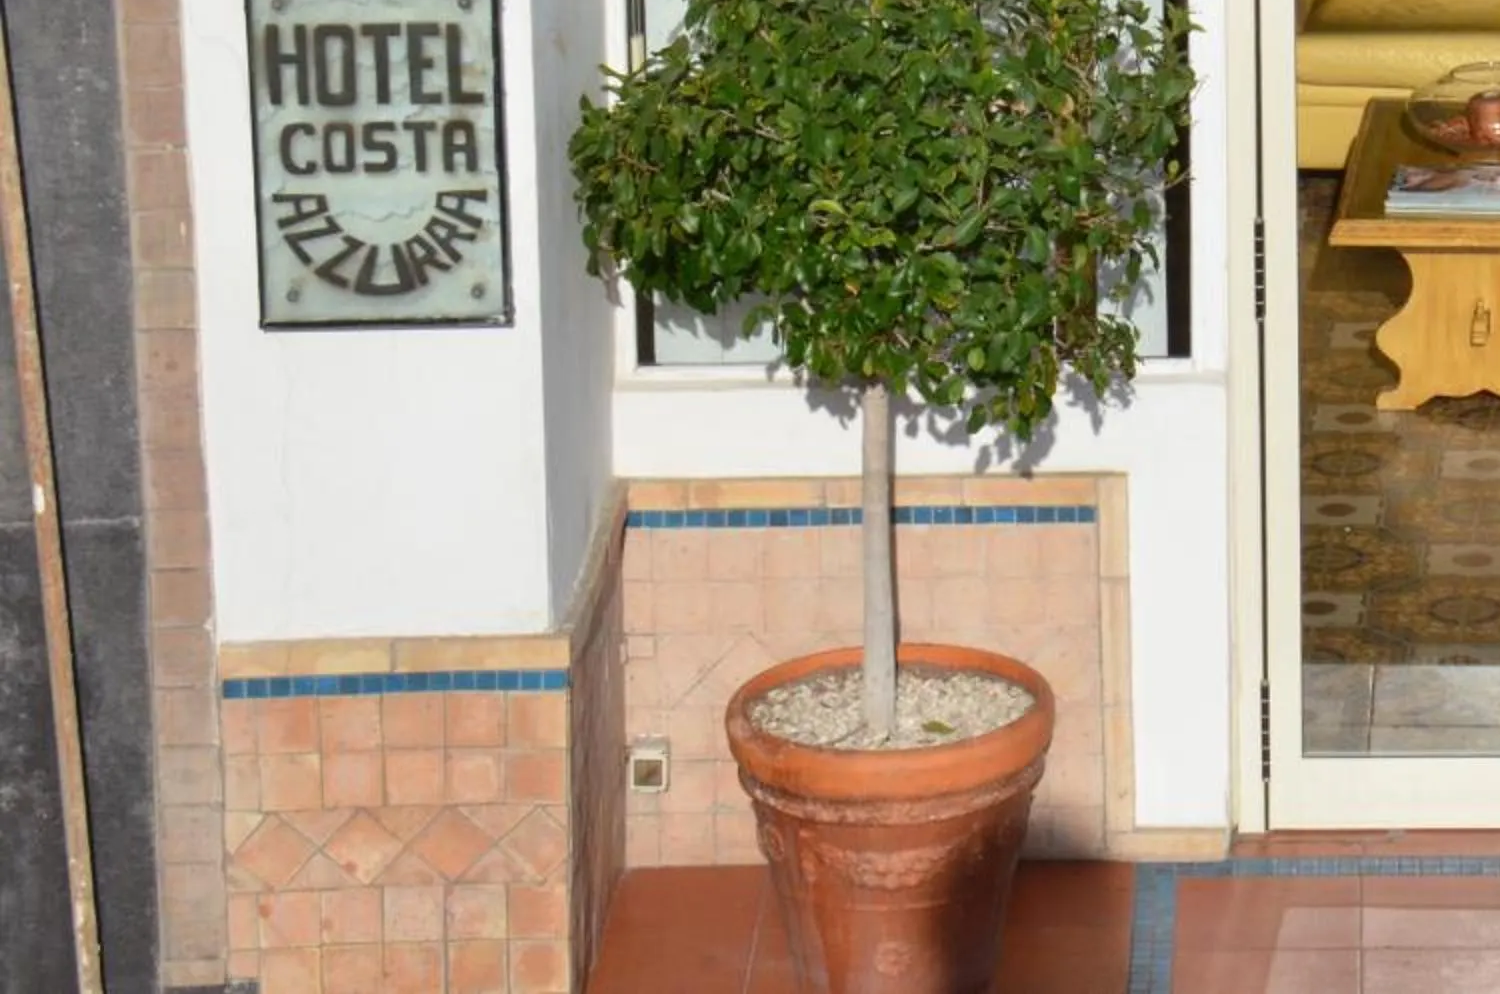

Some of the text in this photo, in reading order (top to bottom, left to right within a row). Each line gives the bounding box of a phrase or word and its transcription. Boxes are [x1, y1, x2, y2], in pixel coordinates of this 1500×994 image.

[265, 22, 485, 106] HOTEL
[280, 120, 478, 175] COSTA
[272, 189, 488, 296] AZZURRA
